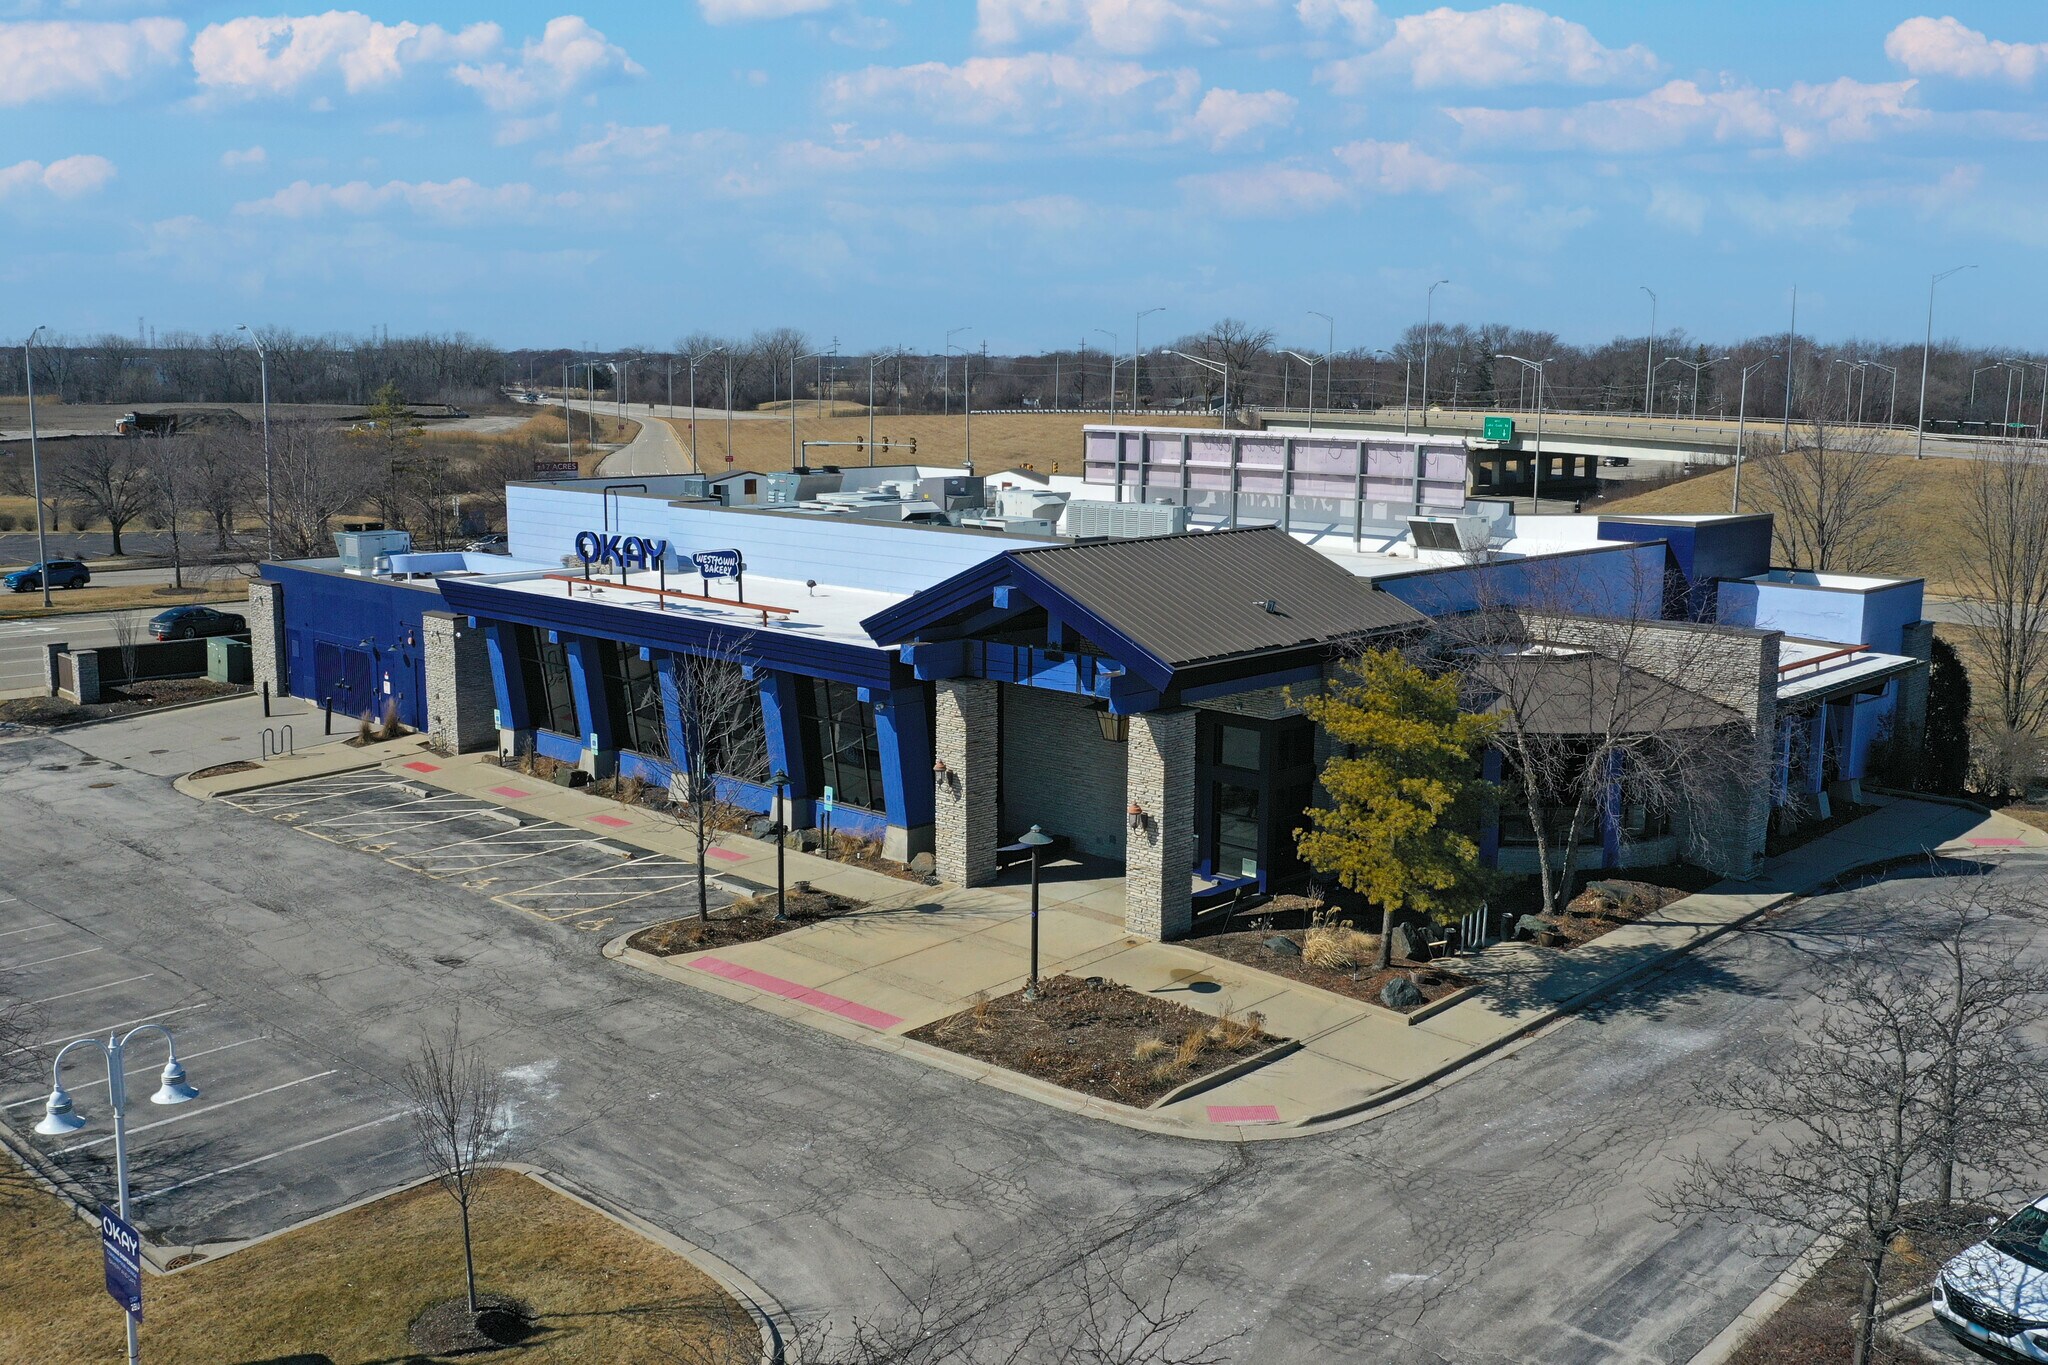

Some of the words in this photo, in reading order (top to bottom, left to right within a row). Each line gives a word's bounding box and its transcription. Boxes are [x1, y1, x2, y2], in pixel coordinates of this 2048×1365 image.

[575, 531, 666, 571] OKAY
[704, 564, 732, 577] BAKERY
[103, 1216, 138, 1256] OKAY
